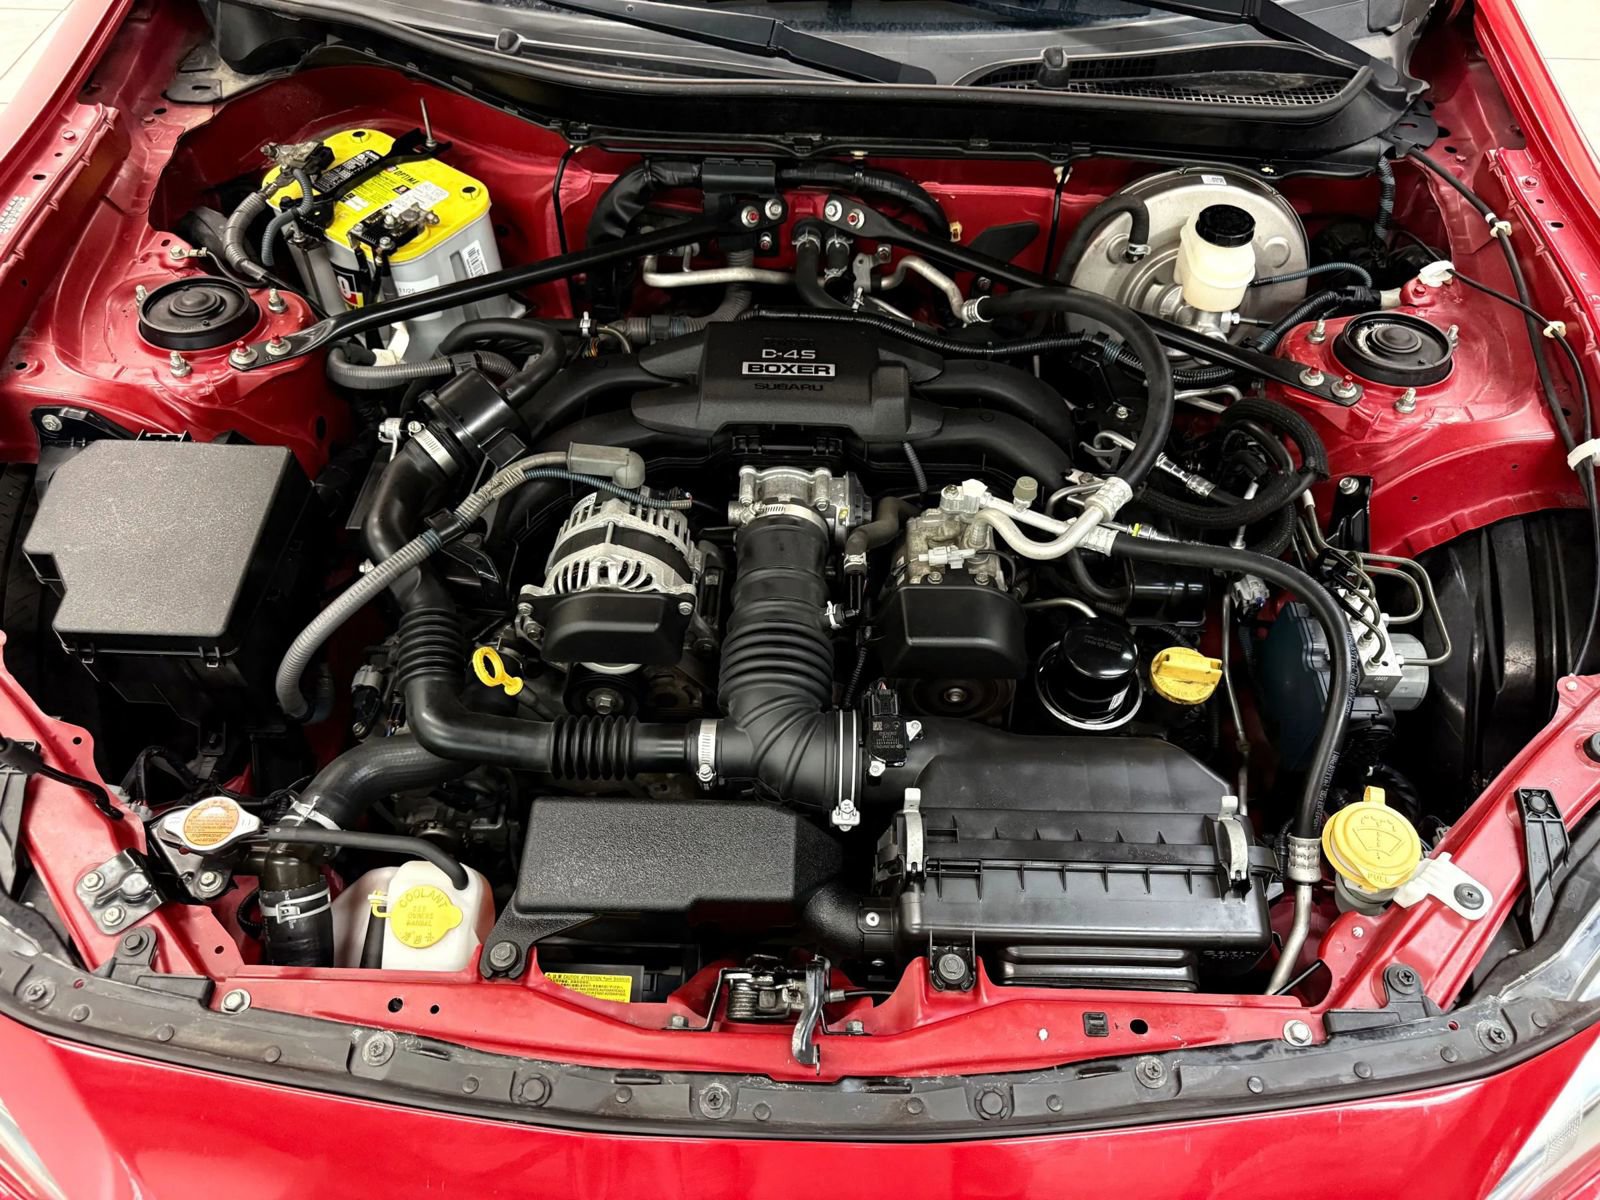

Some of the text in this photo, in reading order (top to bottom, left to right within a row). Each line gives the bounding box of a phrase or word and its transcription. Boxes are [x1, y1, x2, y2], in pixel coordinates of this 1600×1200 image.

[762, 349, 816, 359] D-4S
[748, 364, 831, 375] BOXER
[754, 383, 824, 391] SUBARU
[399, 887, 448, 909] COOLANT
